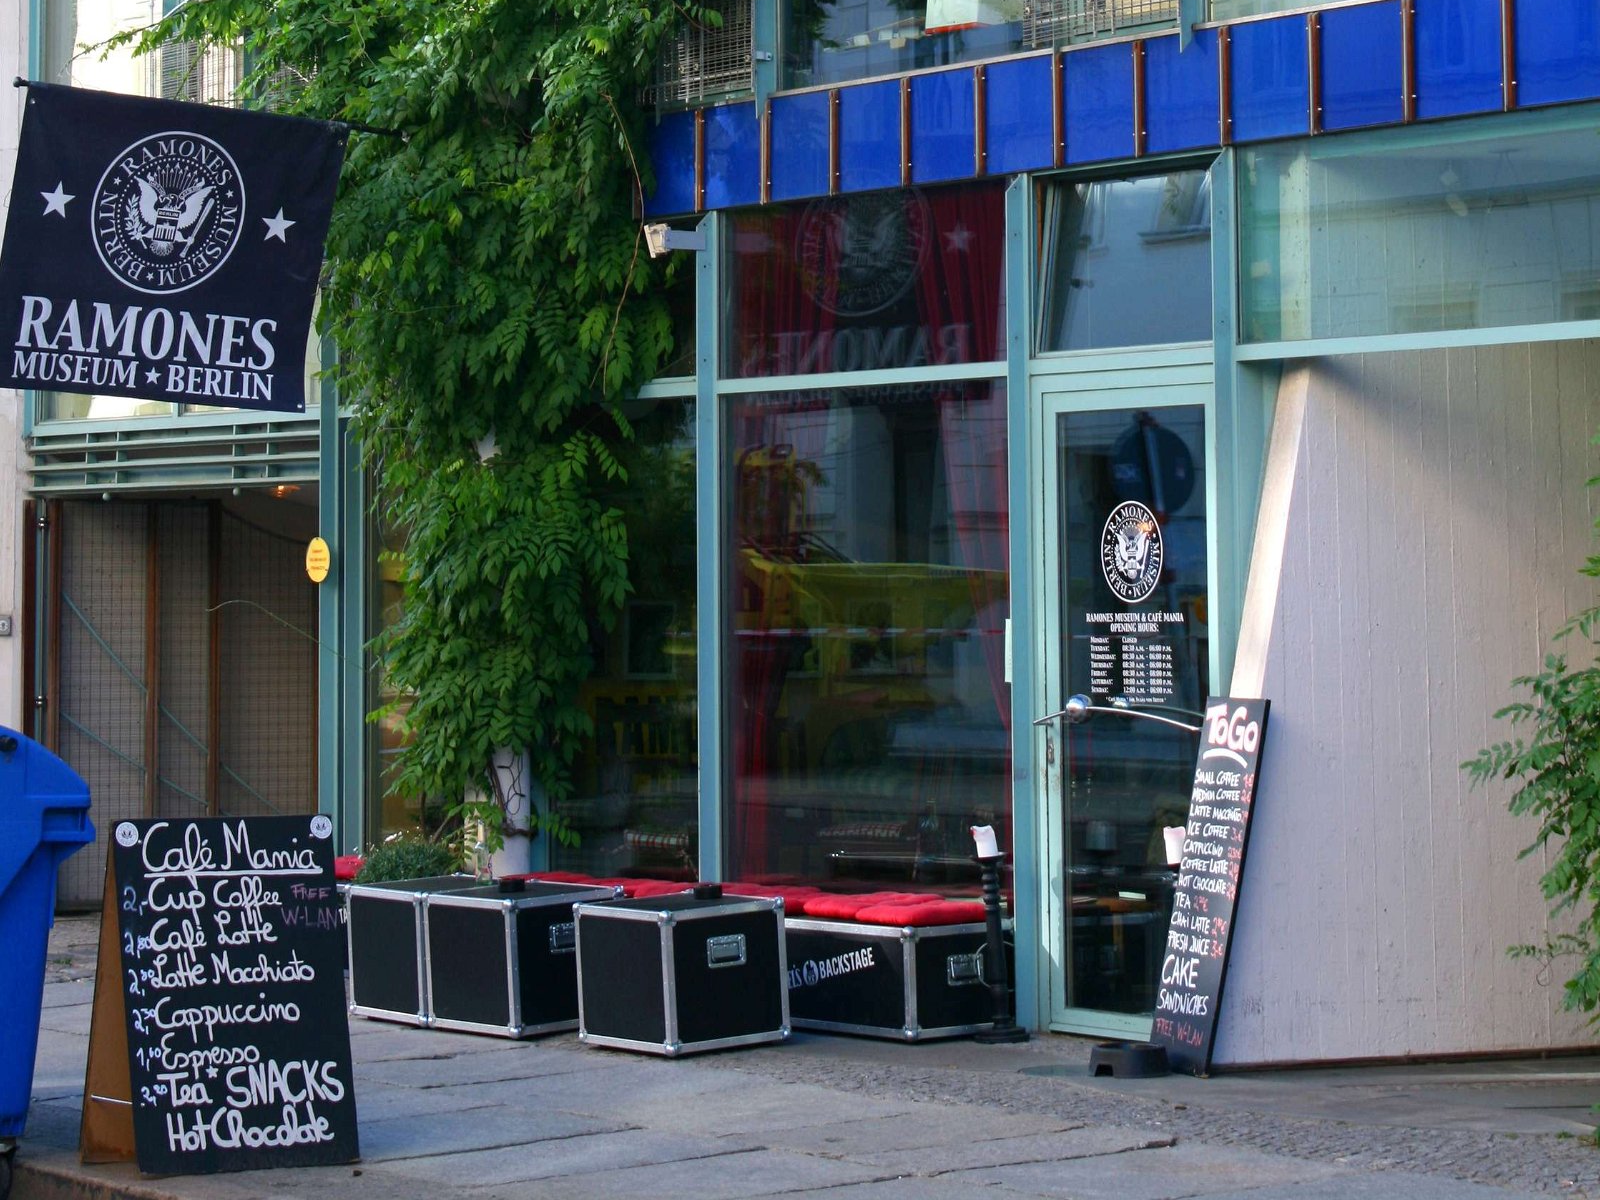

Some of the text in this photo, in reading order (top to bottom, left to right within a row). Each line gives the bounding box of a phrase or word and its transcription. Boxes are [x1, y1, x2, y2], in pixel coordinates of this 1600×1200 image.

[120, 140, 233, 187] RAMONES
[100, 190, 147, 281] BERLIN
[157, 204, 239, 287] MUSEUM
[14, 295, 277, 370] RAMONES
[11, 350, 274, 401] MUSEUM BERLIN
[1108, 507, 1155, 533] RAMONES
[1104, 543, 1128, 597] BERLIN
[1133, 542, 1160, 598] MUSEUM
[1086, 612, 1113, 622] RAMONES
[1114, 612, 1140, 622] MUSEUM
[1147, 611, 1162, 622] CAFÉ
[1163, 612, 1184, 622] MANIA
[1110, 623, 1136, 632] OPENING
[1194, 768, 1215, 785] SMALL
[1216, 770, 1241, 787] COFFEE
[1189, 803, 1212, 817] LATTE
[1216, 788, 1240, 802] COFFEE
[220, 820, 323, 871] Mania
[1187, 820, 1202, 835] ICE
[1202, 822, 1230, 839] COFFEE
[1180, 856, 1210, 871] COFFEE
[1209, 858, 1229, 875] LATTE
[148, 878, 206, 925] Cup
[212, 876, 283, 924] Coffee
[290, 882, 330, 899] FREE
[1175, 892, 1191, 909] TEA
[1178, 873, 1193, 887] HOT
[1193, 875, 1227, 894] CHOCOLATE
[214, 910, 278, 946] Latte
[281, 907, 338, 930] W-LAN
[1190, 915, 1211, 934] LATTE
[1168, 931, 1189, 953] FRESH
[152, 952, 207, 989] Latte
[212, 950, 315, 984] Macchiato
[819, 947, 875, 979] BACKSTAGE
[1161, 954, 1201, 988] CAKE
[155, 993, 300, 1043] Cappuccino
[161, 1032, 260, 1079] Espresso
[157, 1071, 213, 1108] Tea
[226, 1059, 345, 1107] SNACKS
[166, 1102, 335, 1152] Hot Chocolate
